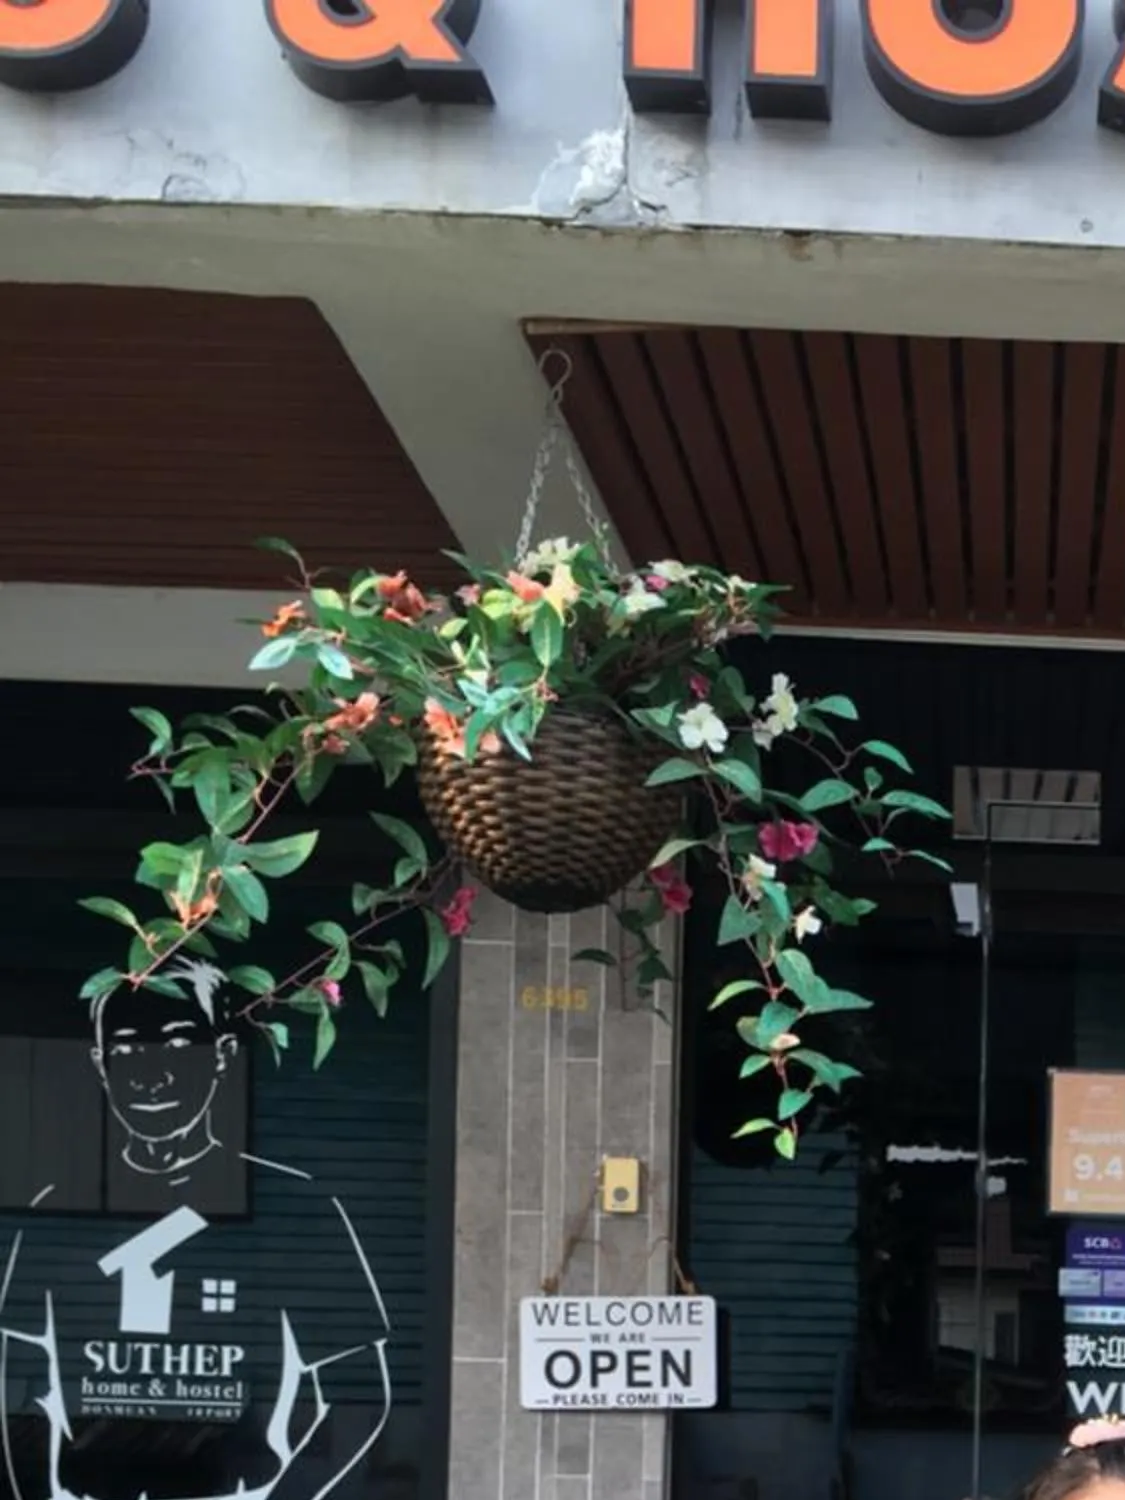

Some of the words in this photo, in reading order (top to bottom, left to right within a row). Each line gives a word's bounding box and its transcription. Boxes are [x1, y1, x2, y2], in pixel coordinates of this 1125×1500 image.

[1073, 1154, 1123, 1180] 9.4
[532, 1301, 704, 1327] WELCOME
[590, 1333, 610, 1344] WE
[618, 1333, 645, 1343] ARE
[84, 1340, 245, 1377] SUTHEP
[544, 1349, 692, 1390] OPEN
[81, 1376, 141, 1396] home
[148, 1378, 165, 1397] &
[175, 1378, 243, 1399] hostel
[552, 1393, 608, 1405] PLEASE
[616, 1393, 659, 1405] COME
[668, 1393, 684, 1405] IN
